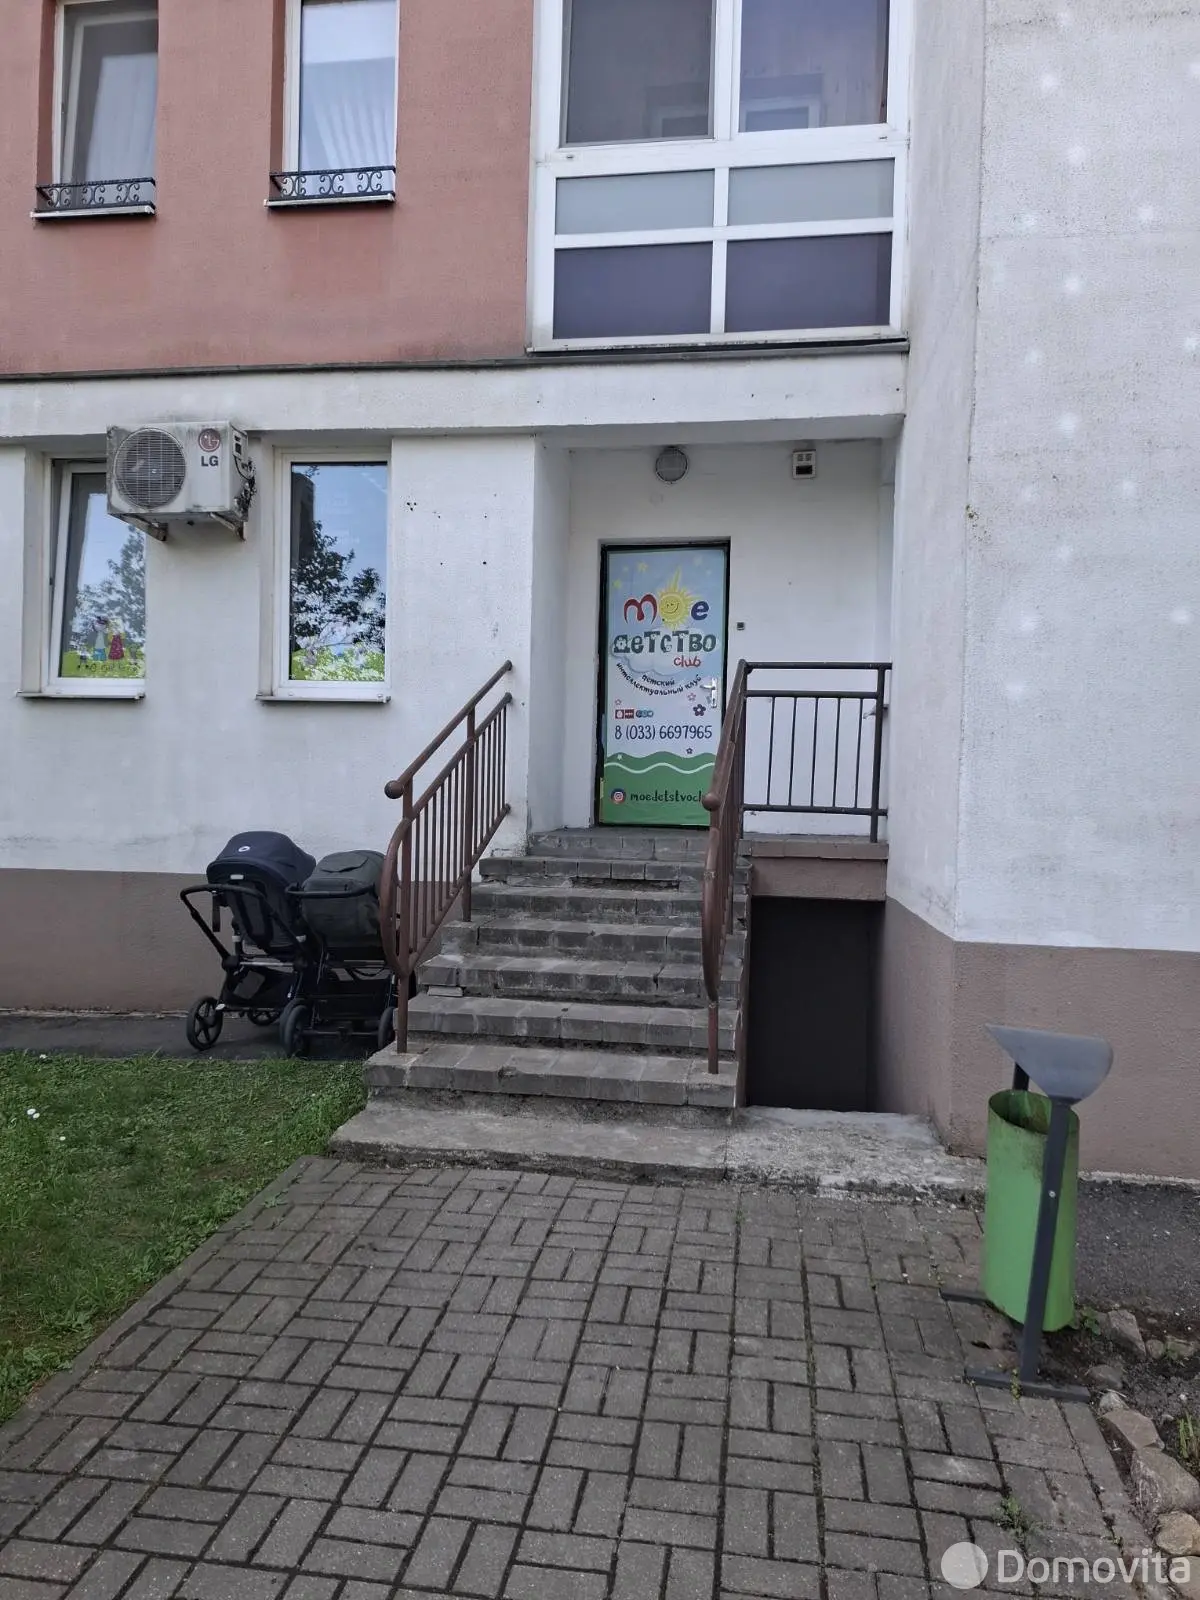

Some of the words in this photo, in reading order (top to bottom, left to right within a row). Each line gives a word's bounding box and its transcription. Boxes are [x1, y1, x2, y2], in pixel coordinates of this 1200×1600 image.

[201, 455, 219, 467] LG
[673, 655, 702, 668] club
[616, 662, 684, 696] интеллектуальный
[685, 674, 702, 690] клуб
[641, 674, 675, 686] детский
[614, 725, 623, 740] 8
[625, 725, 656, 740] (033)
[659, 725, 713, 740] 6697965
[630, 790, 702, 802] moedetstvocl
